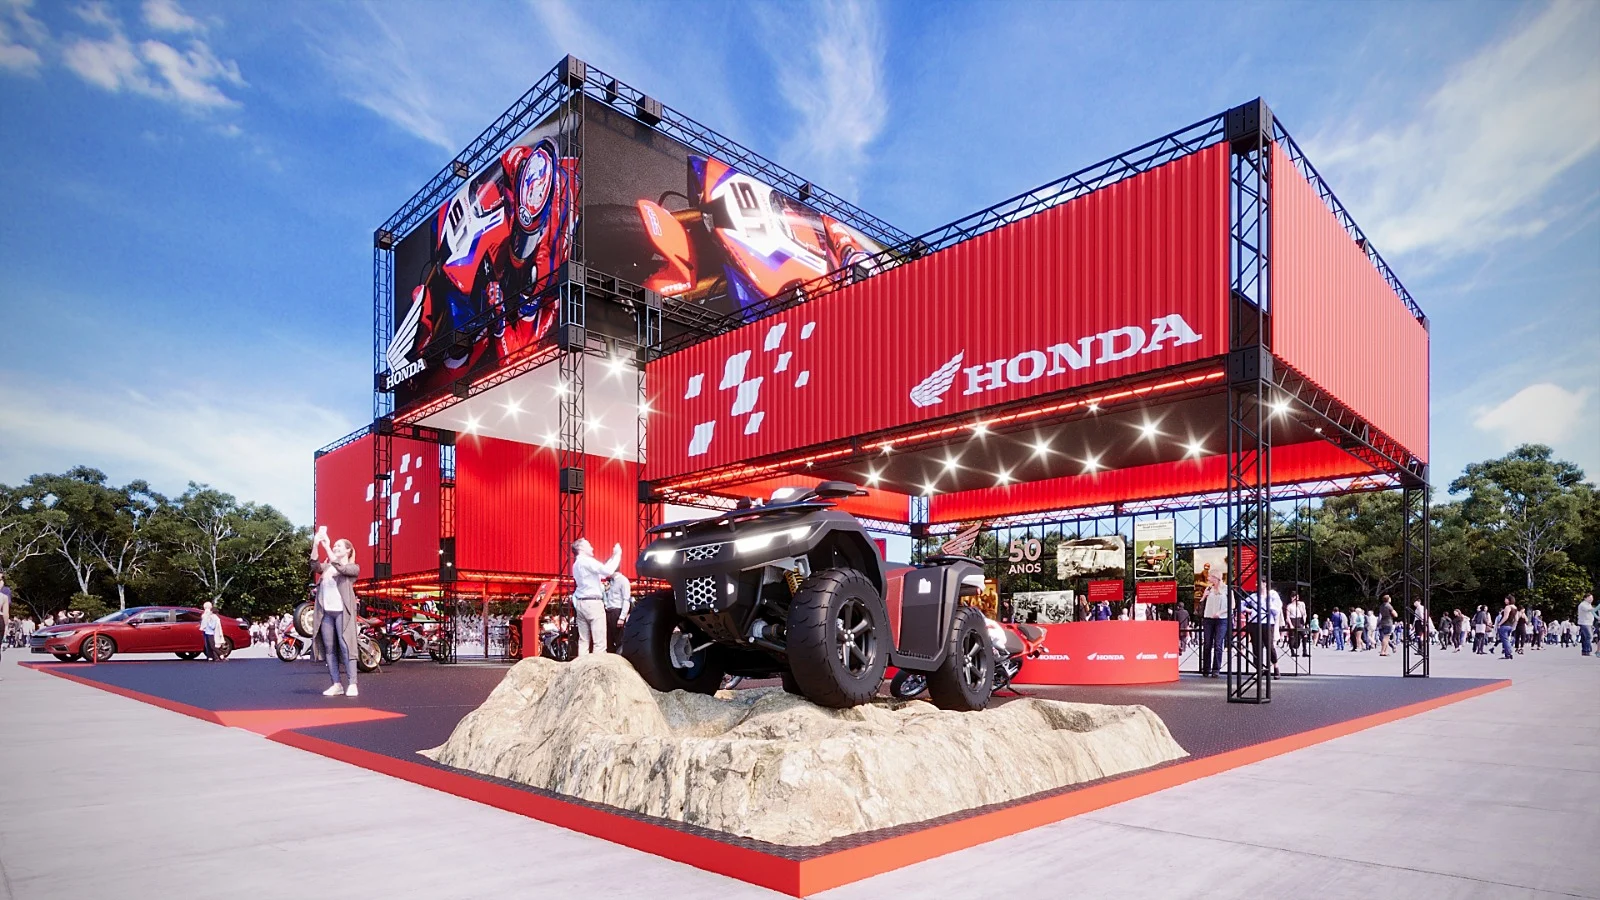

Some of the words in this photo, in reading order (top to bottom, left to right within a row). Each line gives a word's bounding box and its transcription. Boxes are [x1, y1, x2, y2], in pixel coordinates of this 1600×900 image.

[962, 313, 1203, 396] HONDA
[386, 358, 426, 390] HONDA
[1008, 538, 1042, 562] 50
[1008, 562, 1042, 575] ANOS
